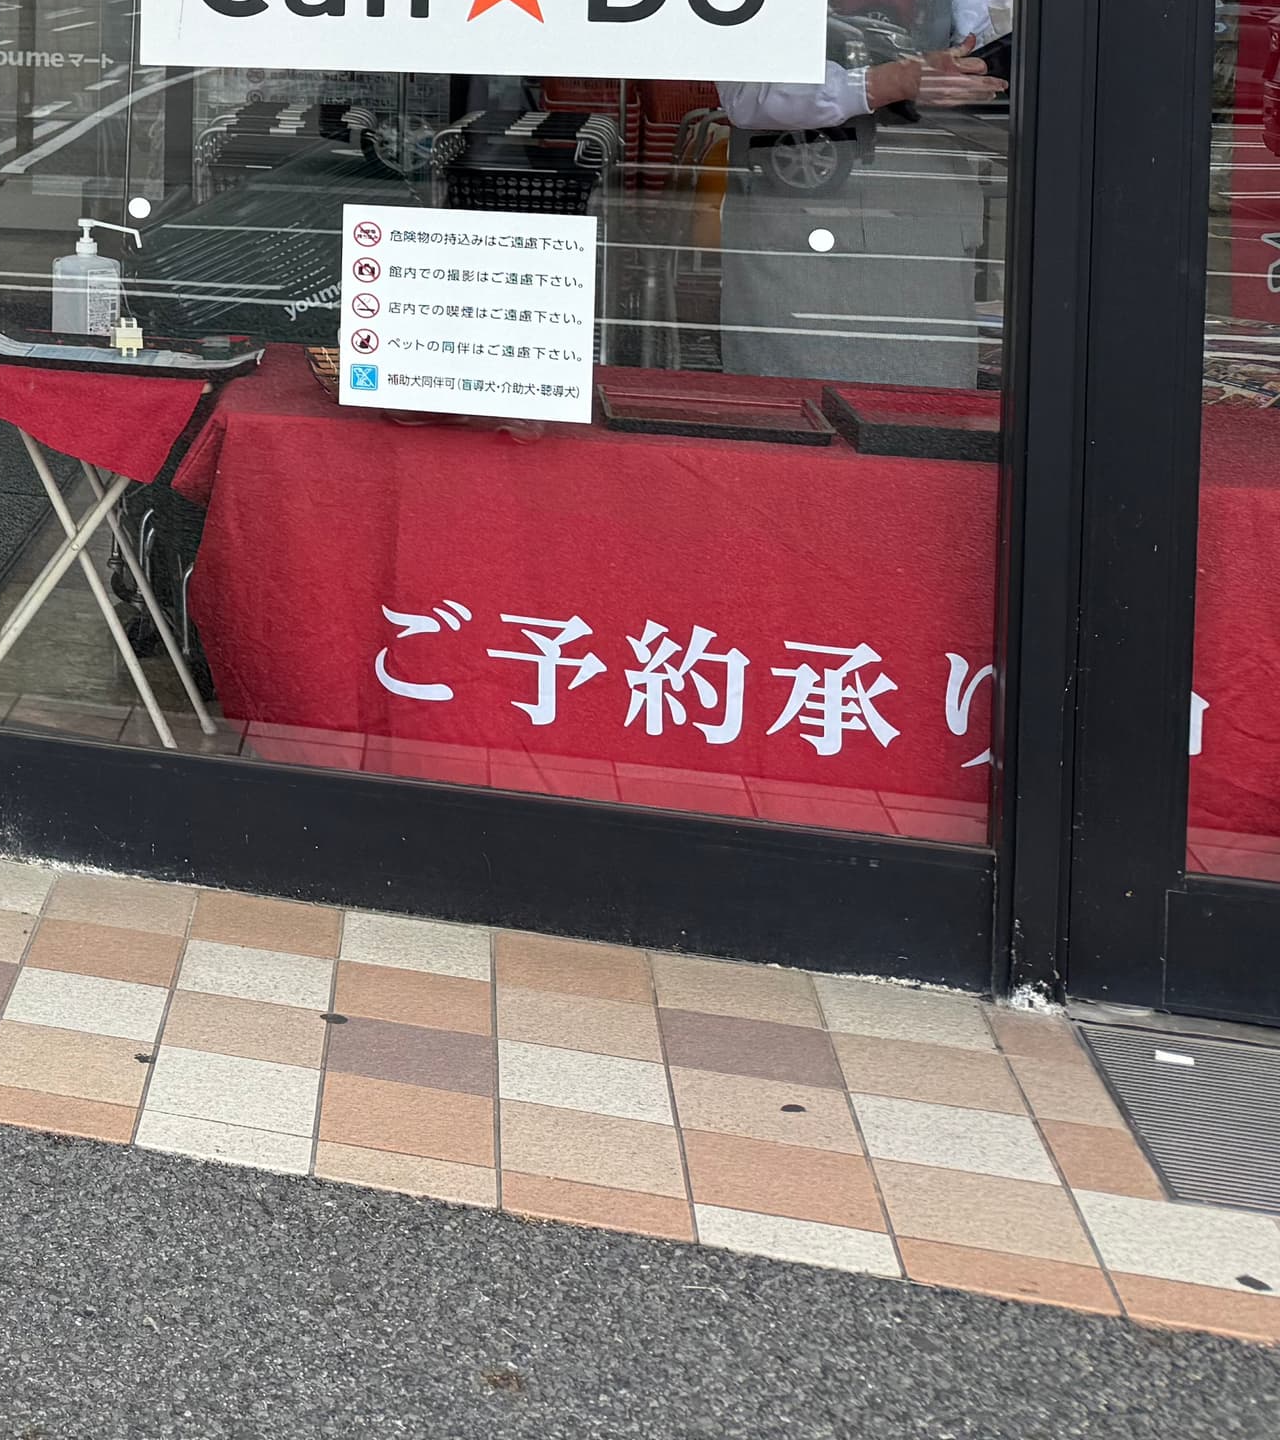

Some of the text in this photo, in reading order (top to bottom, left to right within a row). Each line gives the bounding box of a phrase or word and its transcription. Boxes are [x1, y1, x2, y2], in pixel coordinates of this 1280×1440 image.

[390, 229, 585, 253] 危険物の持込みはご遠慮下さい。
[389, 265, 584, 289] 館内での撮影はご遠慮下さい。
[388, 302, 583, 326] 店内での喫煙はご遠慮下さい。
[387, 338, 582, 362] ペットの同伴はご遠慮下さい。
[375, 599, 1209, 769] ご予約承り
